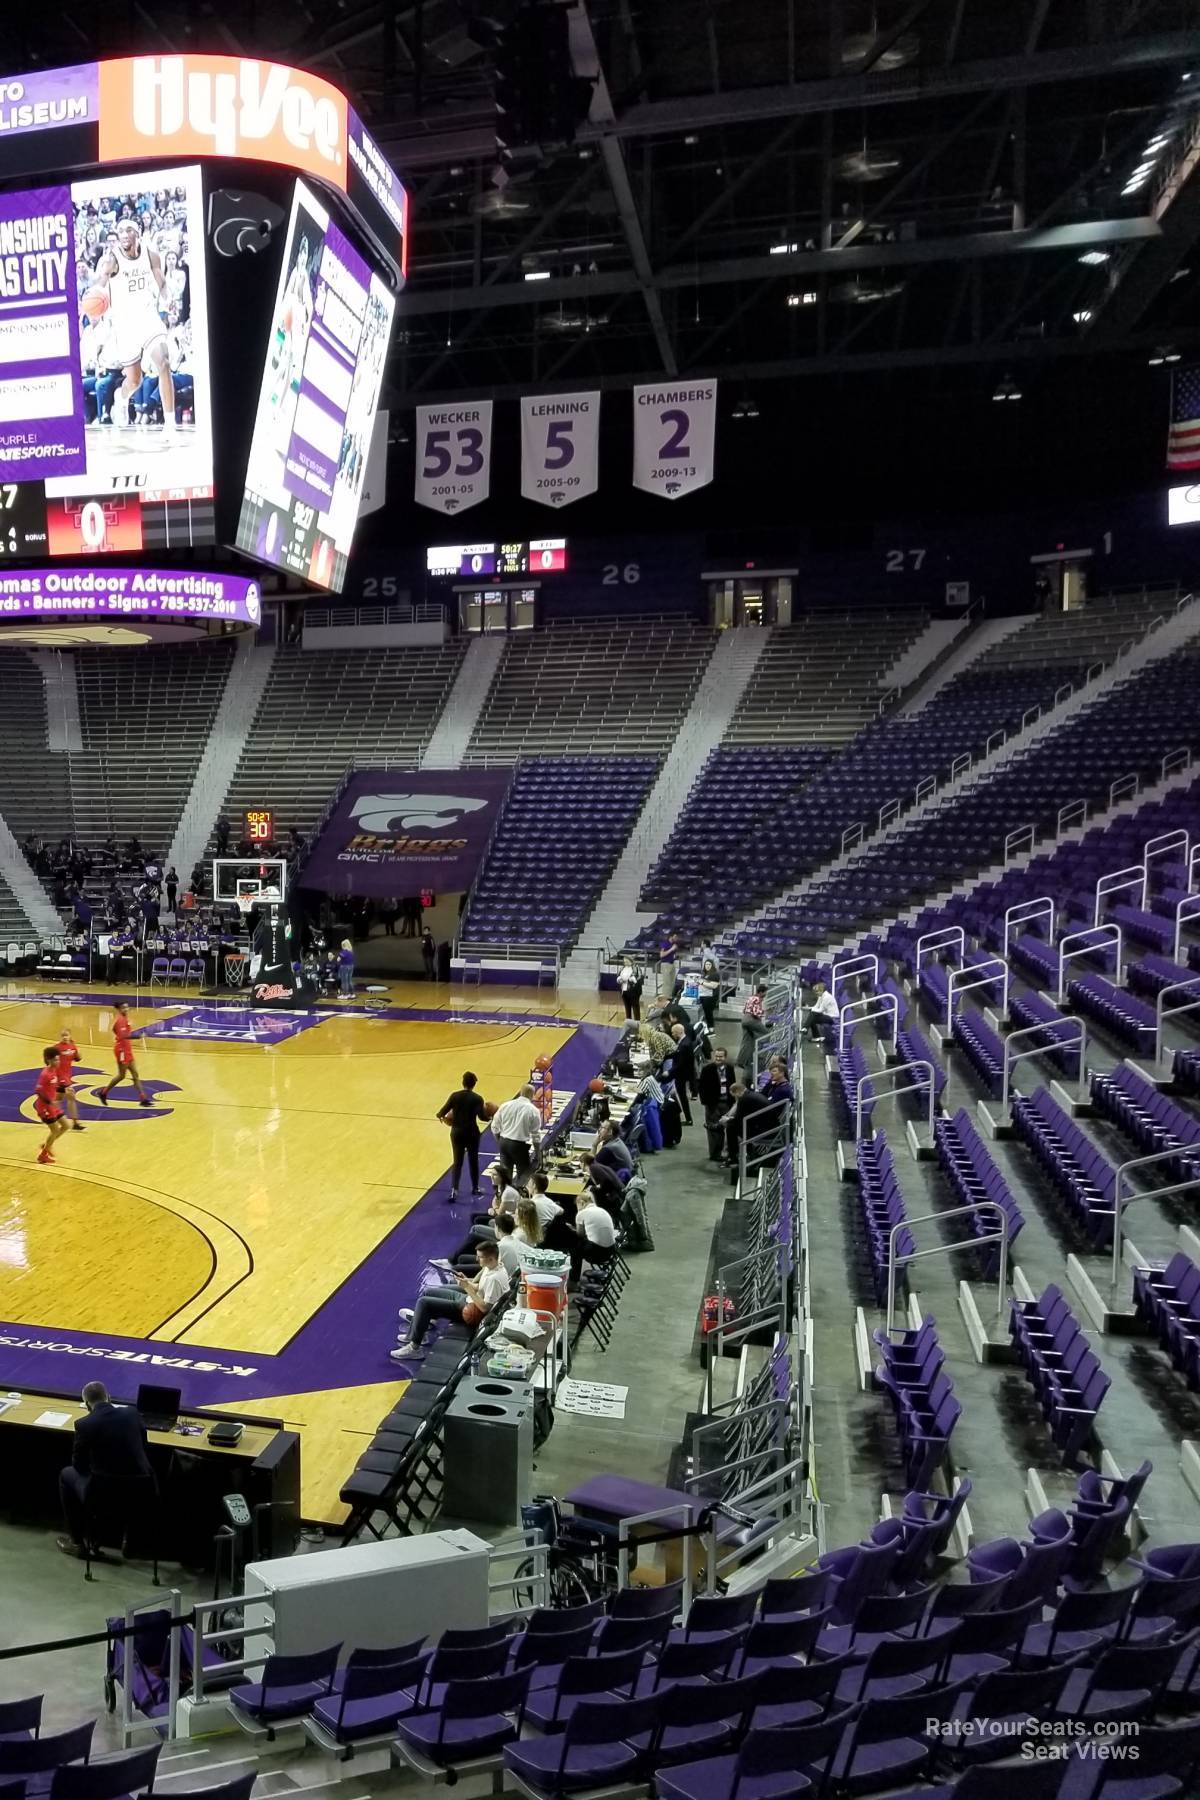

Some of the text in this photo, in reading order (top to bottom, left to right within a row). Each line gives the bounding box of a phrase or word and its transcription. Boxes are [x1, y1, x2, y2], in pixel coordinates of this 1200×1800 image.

[22, 250, 68, 294] CITY
[129, 277, 145, 292] 20
[638, 389, 713, 405] CHAMBERS
[531, 402, 589, 416] LEHNING
[428, 411, 480, 425] WECKER
[658, 409, 690, 460] 2
[422, 427, 484, 478] 53
[544, 420, 575, 470] 5
[651, 466, 696, 479] 2009-13
[111, 474, 147, 488] TTU
[536, 476, 580, 488] 2005-09
[432, 483, 473, 496] 2001-05
[81, 501, 105, 546] 0
[9, 527, 17, 538] 4
[9, 541, 17, 552] 0
[1104, 534, 1112, 553] 1
[472, 555, 483, 572] 0
[541, 551, 553, 567] 0
[886, 550, 926, 570] 27
[602, 564, 641, 583] 26
[45, 574, 128, 592] Outdoor
[132, 573, 224, 598] Advertising
[362, 577, 397, 597] 25
[33, 595, 94, 610] Banners
[108, 595, 148, 611] Signs
[247, 812, 270, 821] 50:27
[250, 823, 268, 838] 30
[347, 835, 468, 854] Briggs
[337, 853, 380, 862] GMC
